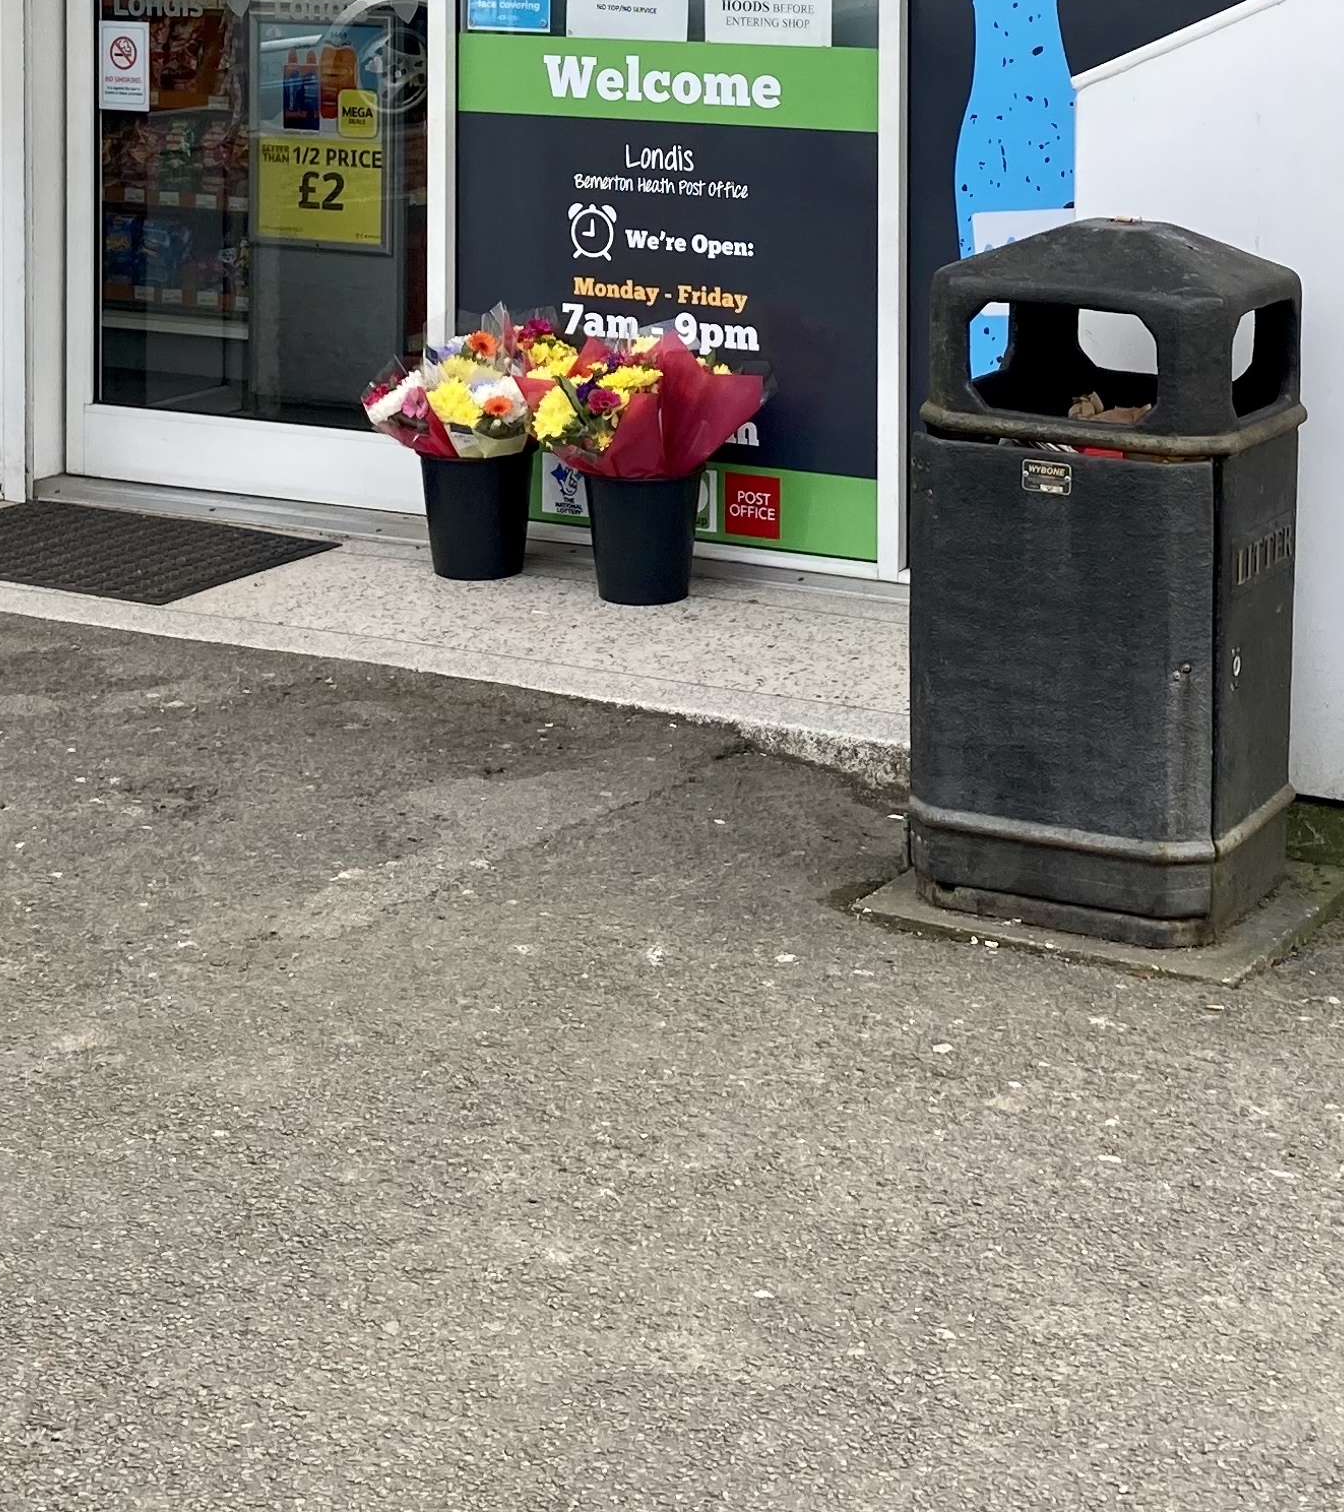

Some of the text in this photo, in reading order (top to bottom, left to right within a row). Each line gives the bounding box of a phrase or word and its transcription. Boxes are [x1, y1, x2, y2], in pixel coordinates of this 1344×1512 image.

[499, 0, 540, 11] covering
[633, 7, 657, 15] SERVICE
[722, 0, 814, 14] HOODS BEFORE
[726, 16, 810, 29] ENTERING SHOP
[544, 55, 781, 109] Welcome
[342, 106, 373, 117] MEGA
[292, 146, 382, 168] 1/2 PRICE
[625, 144, 694, 172] Londis
[298, 171, 344, 210] £2
[574, 173, 748, 199] Bemerton Heath Post Office
[625, 229, 754, 259] We're Open:
[573, 277, 748, 313] Monday Friday
[562, 302, 760, 355] 7am 9pm
[1028, 465, 1065, 476] WYBONE
[737, 491, 771, 506] POST
[730, 504, 776, 522] OFFICE
[1237, 524, 1292, 585] LITTER
